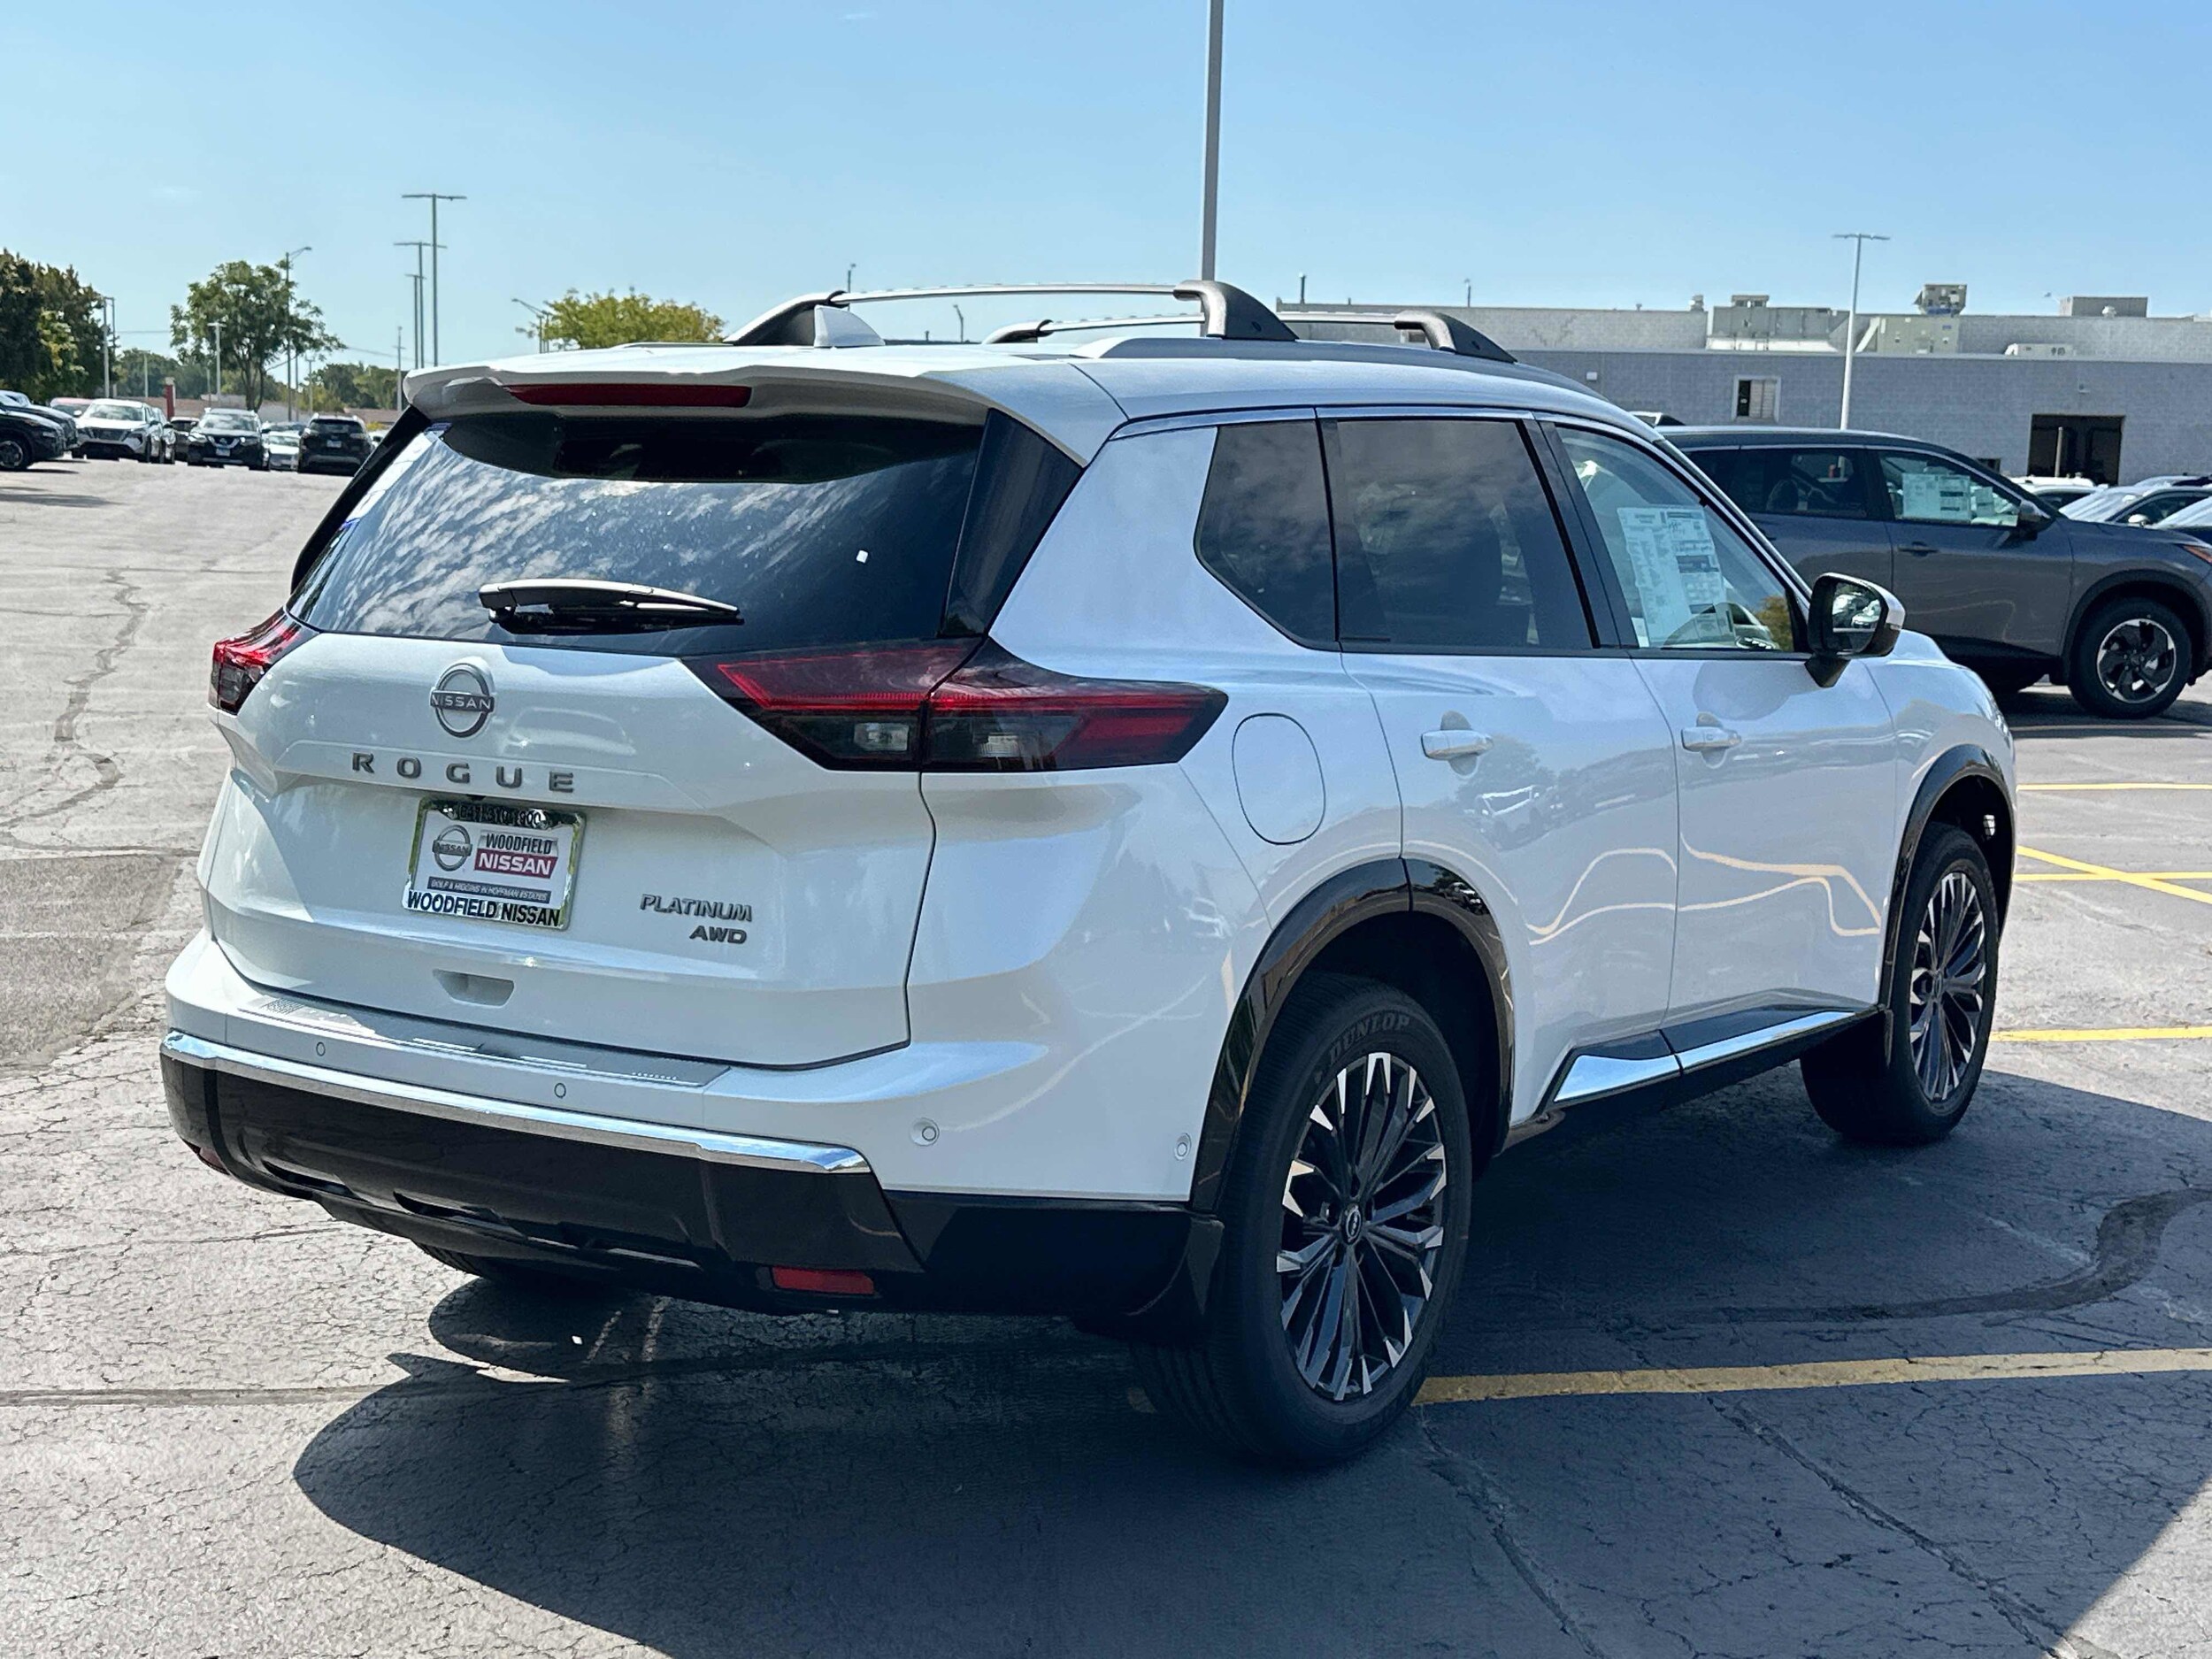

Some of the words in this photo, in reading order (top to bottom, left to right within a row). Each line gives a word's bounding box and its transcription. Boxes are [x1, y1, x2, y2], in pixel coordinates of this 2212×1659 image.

[432, 694, 492, 710] NISSAN
[352, 752, 573, 793] ROGUE
[486, 833, 553, 855] WOODFIELD
[478, 852, 552, 876] NISSAN
[407, 890, 497, 918] WOODFIELD
[500, 902, 561, 926] NISSAN
[640, 893, 753, 923] PLATINUM
[688, 925, 748, 945] AWD
[1329, 1012, 1411, 1068] DUNLOP
